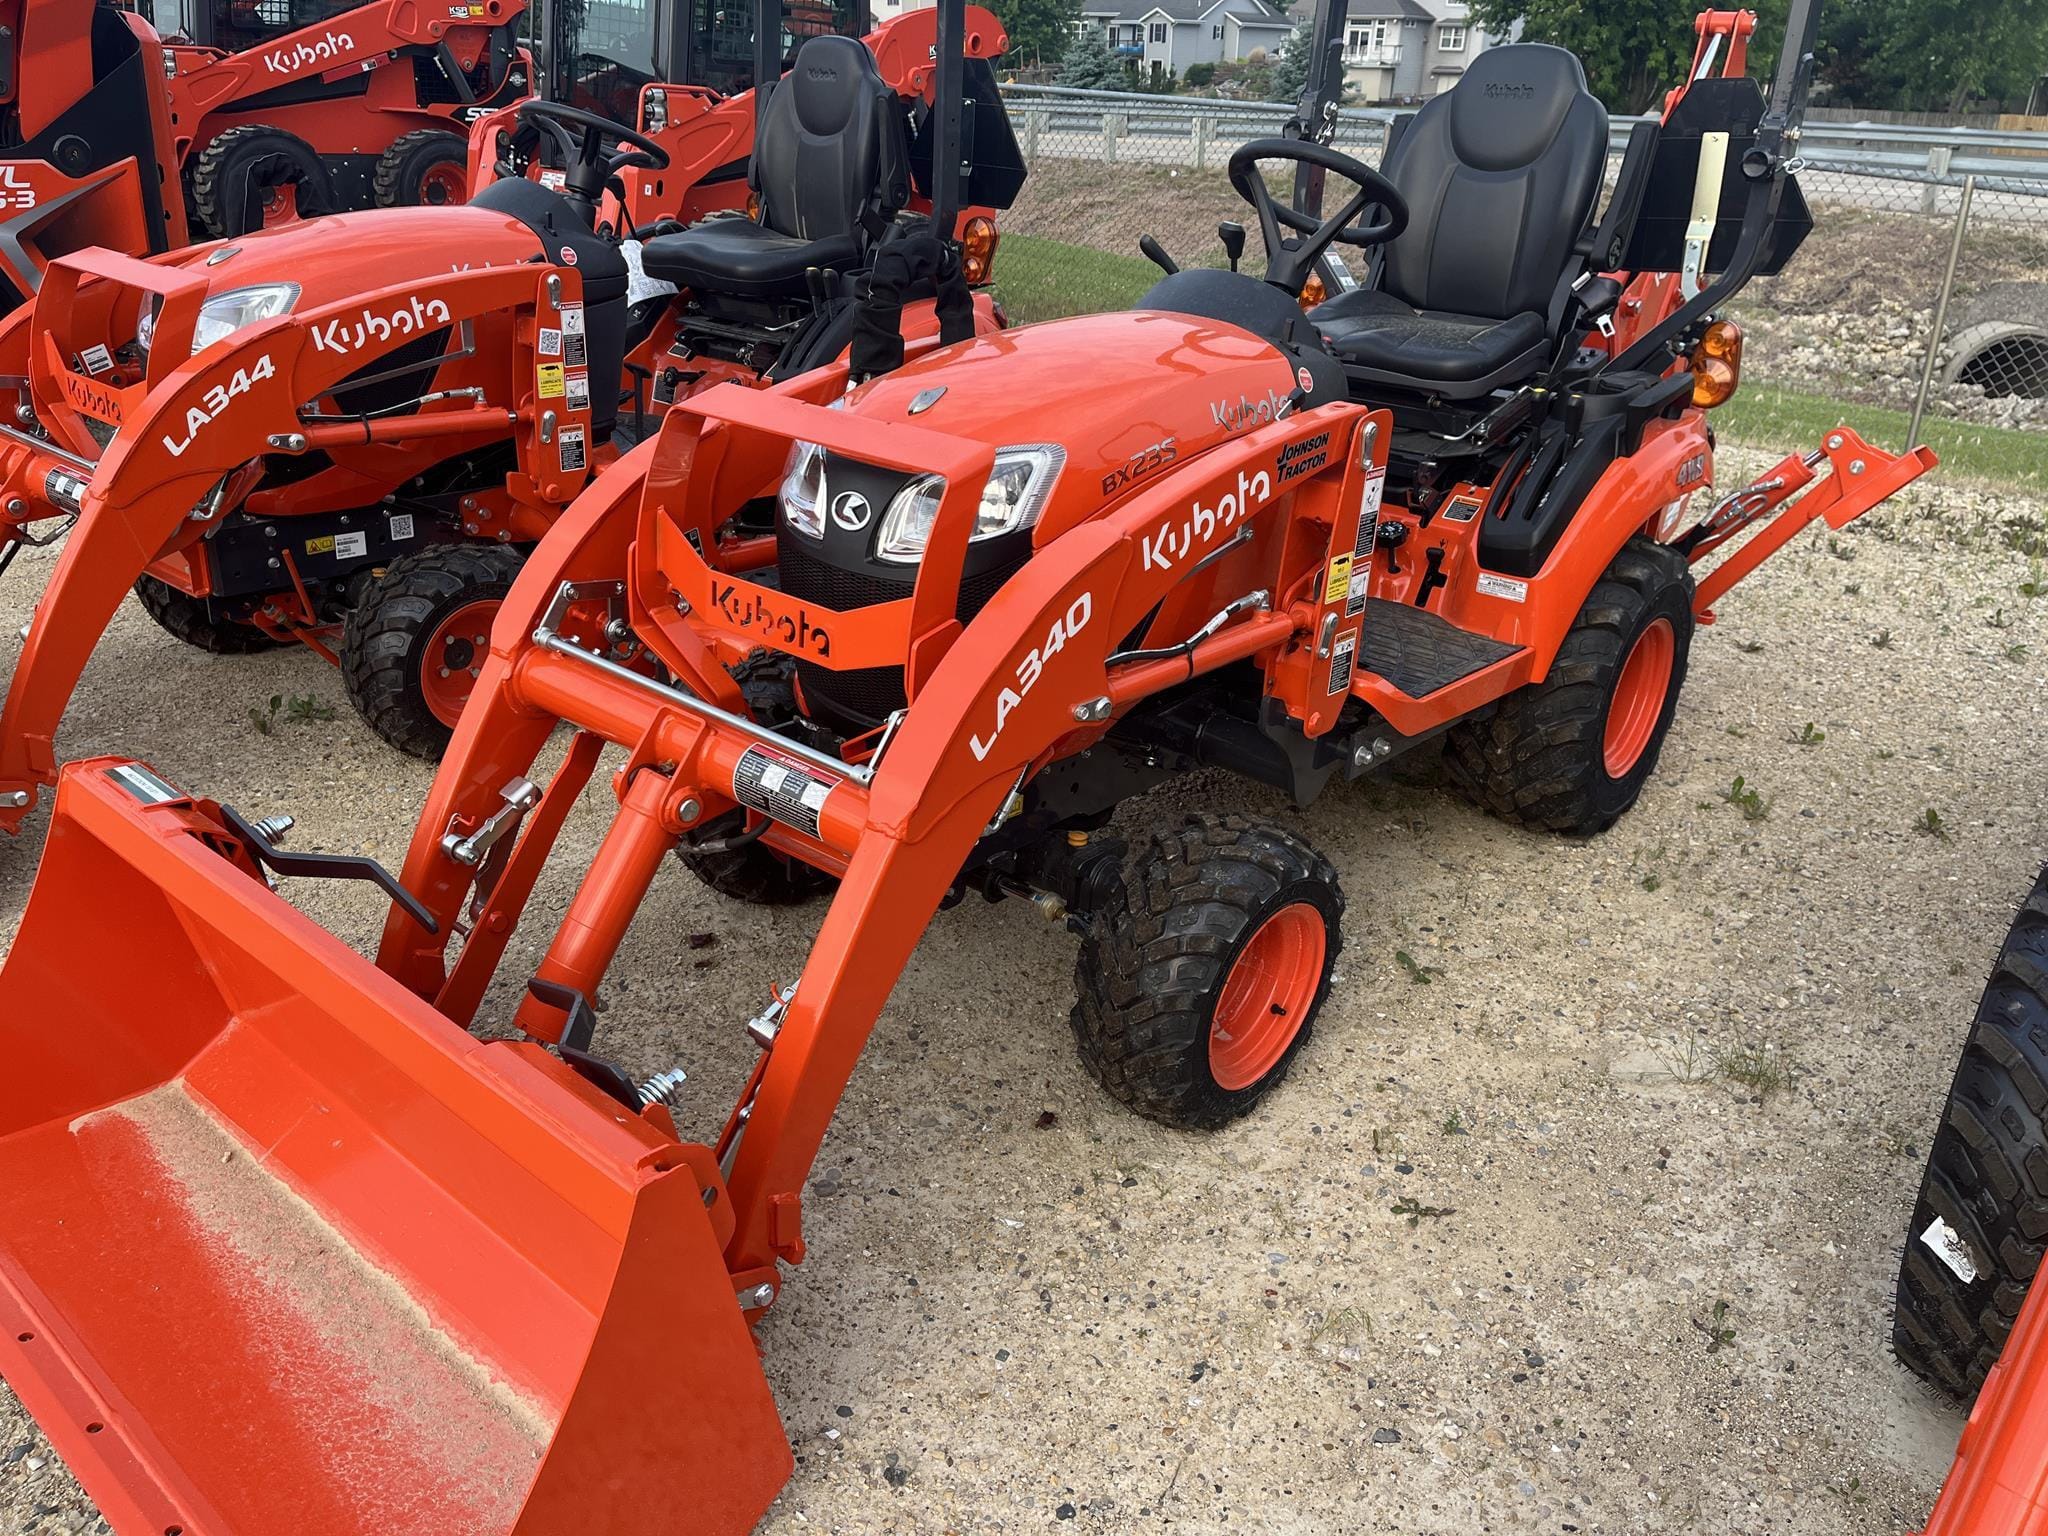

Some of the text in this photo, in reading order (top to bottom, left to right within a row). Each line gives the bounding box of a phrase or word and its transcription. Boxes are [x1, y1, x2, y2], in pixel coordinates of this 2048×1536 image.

[263, 31, 355, 74] Kubota
[310, 296, 451, 354] Kubota
[67, 376, 122, 422] Kubota
[162, 353, 276, 458] LA344
[1102, 436, 1178, 497] BX23S
[1276, 432, 1330, 465] JOHNSON
[1277, 452, 1327, 483] TRACTOR
[1142, 469, 1271, 571] Kubota
[711, 580, 830, 658] Kubota
[969, 591, 1092, 762] LA340
[785, 758, 811, 773] DANGER
